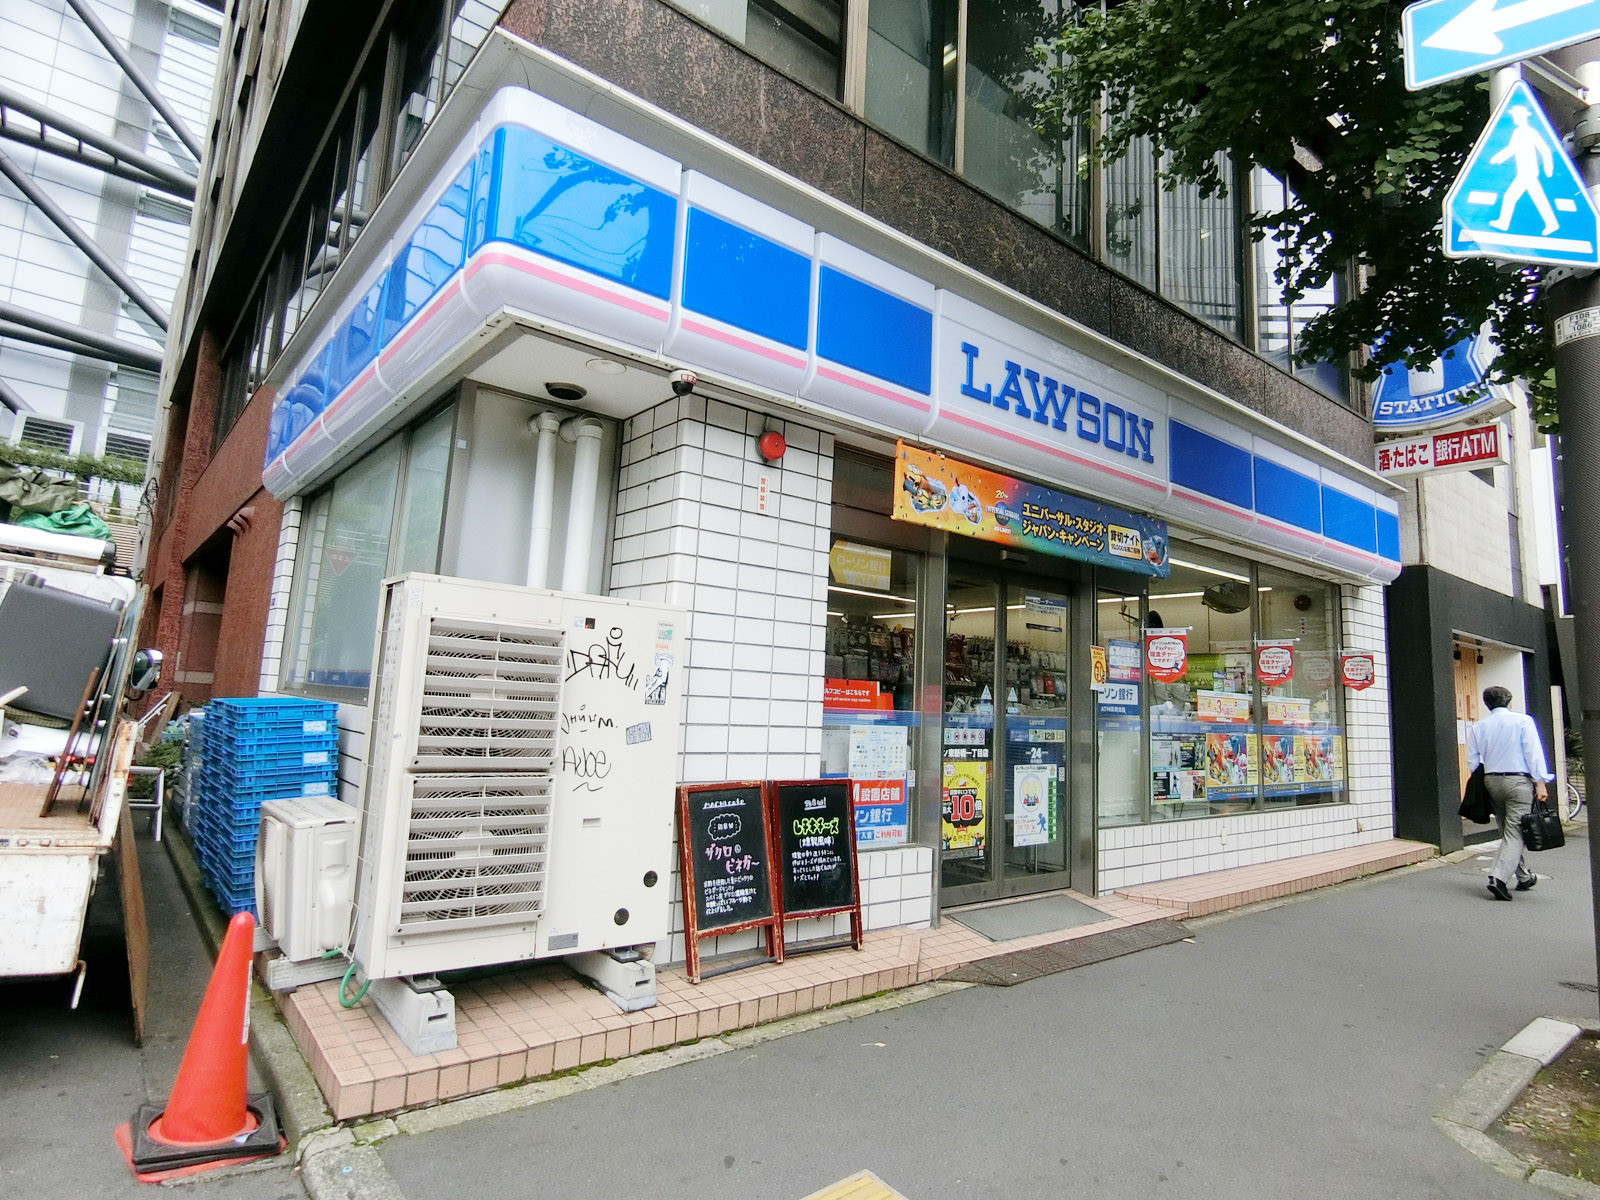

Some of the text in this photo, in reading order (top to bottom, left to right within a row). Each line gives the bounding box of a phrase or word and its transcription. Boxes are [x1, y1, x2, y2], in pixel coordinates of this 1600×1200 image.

[960, 341, 1154, 464] LAWSON
[1436, 431, 1496, 462] 銀行ATM
[1022, 520, 1105, 552] ジャパン・キャンペーン
[1110, 529, 1140, 547] 貸切ナイト
[836, 554, 888, 573] ローソン銀行
[1030, 747, 1042, 759] 24
[951, 794, 975, 821] 10
[875, 829, 903, 839] ご利用可能
[705, 843, 733, 861] ザクロ
